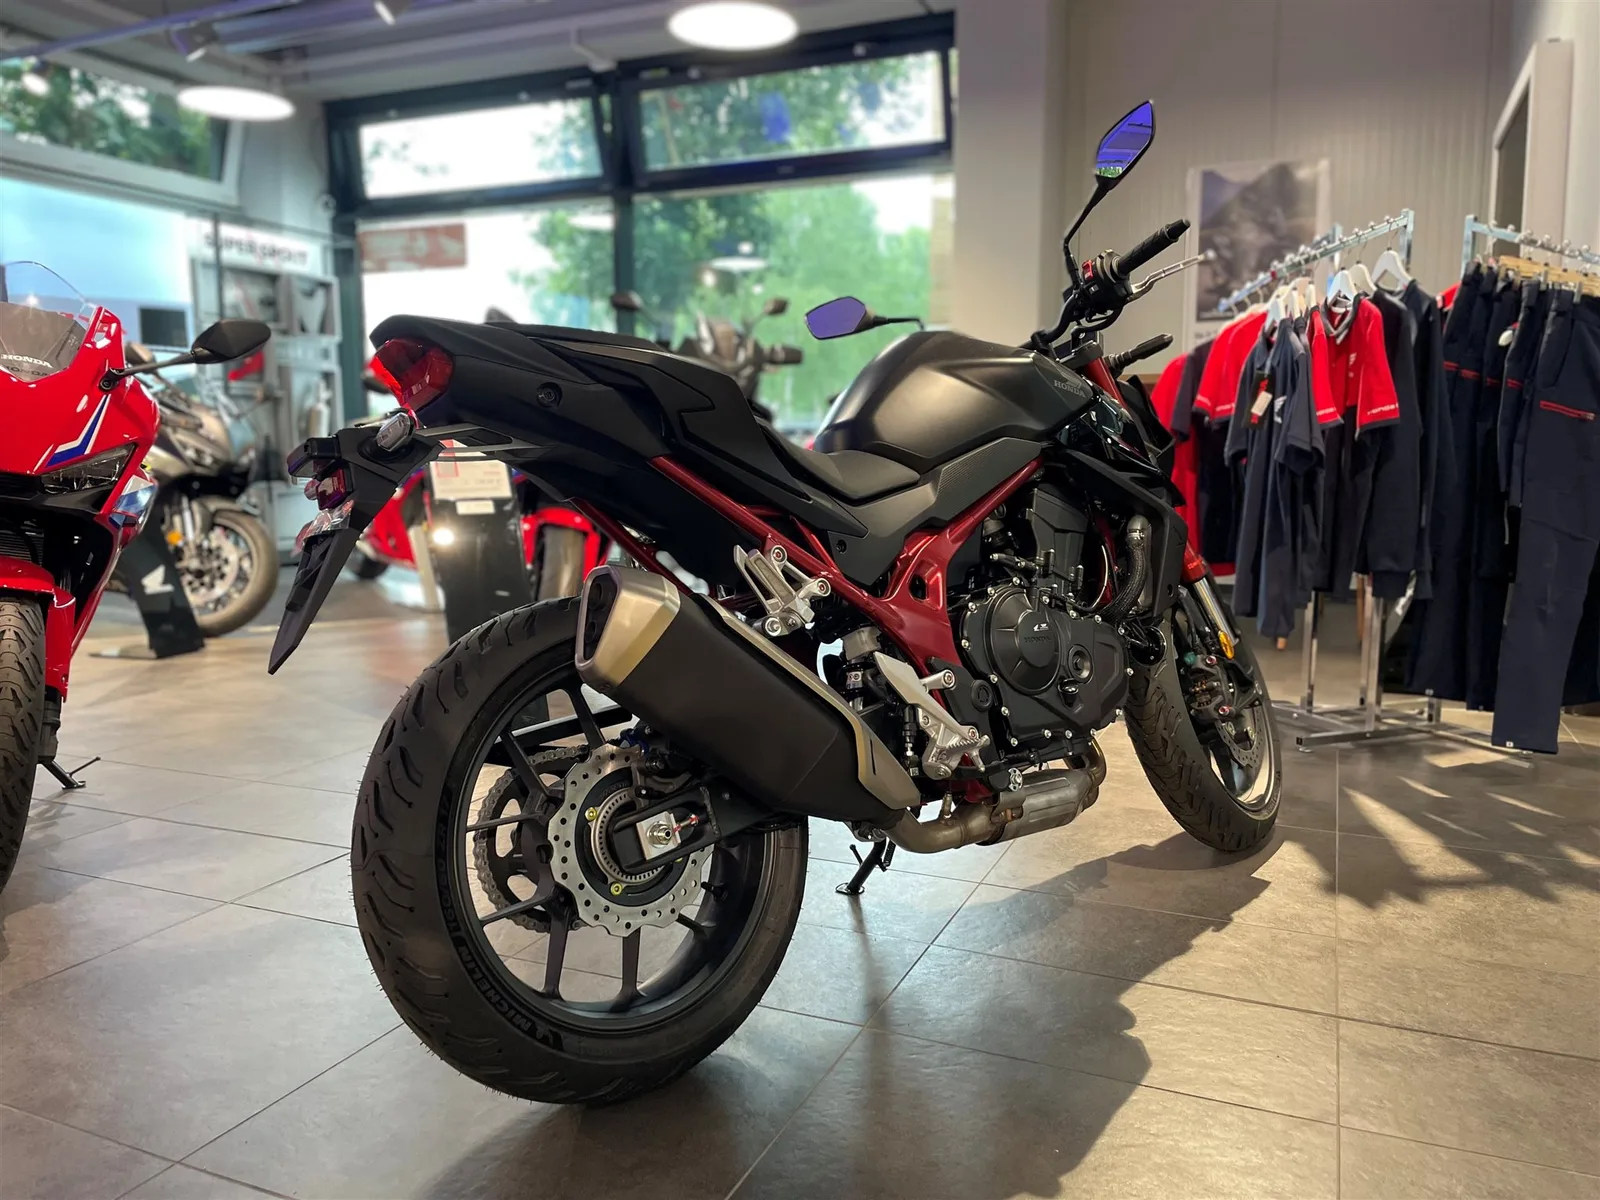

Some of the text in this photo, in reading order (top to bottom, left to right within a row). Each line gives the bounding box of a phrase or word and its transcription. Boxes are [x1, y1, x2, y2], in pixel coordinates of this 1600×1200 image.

[1, 354, 53, 368] HONDA
[1053, 380, 1086, 398] HONDA
[459, 945, 533, 1031] MICHELIN
